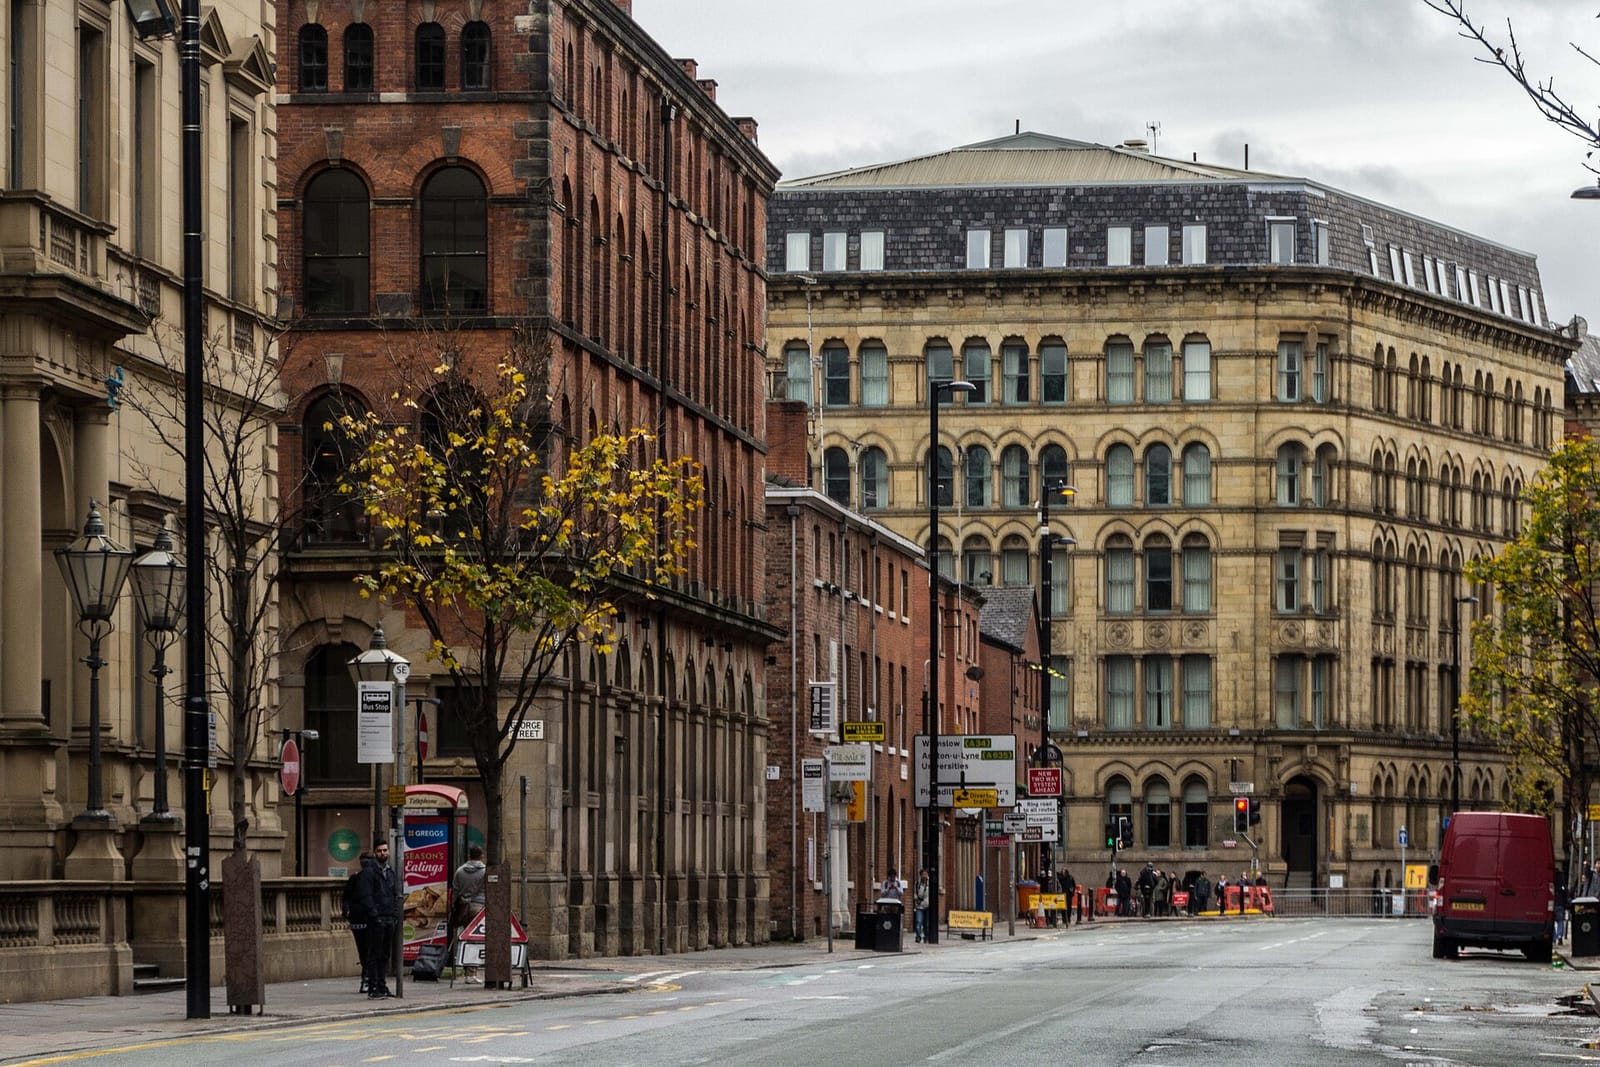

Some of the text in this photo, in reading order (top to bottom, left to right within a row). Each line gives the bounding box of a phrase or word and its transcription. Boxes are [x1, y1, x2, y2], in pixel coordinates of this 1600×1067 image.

[396, 665, 407, 674] SE
[375, 703, 389, 711] Stop
[510, 721, 542, 729] GORGE
[922, 739, 960, 747] Wslow
[922, 752, 979, 760] Aton-u-Lyne
[921, 788, 953, 796] Piadil
[405, 851, 444, 859] SEASON'S
[405, 860, 444, 876] Eatings
